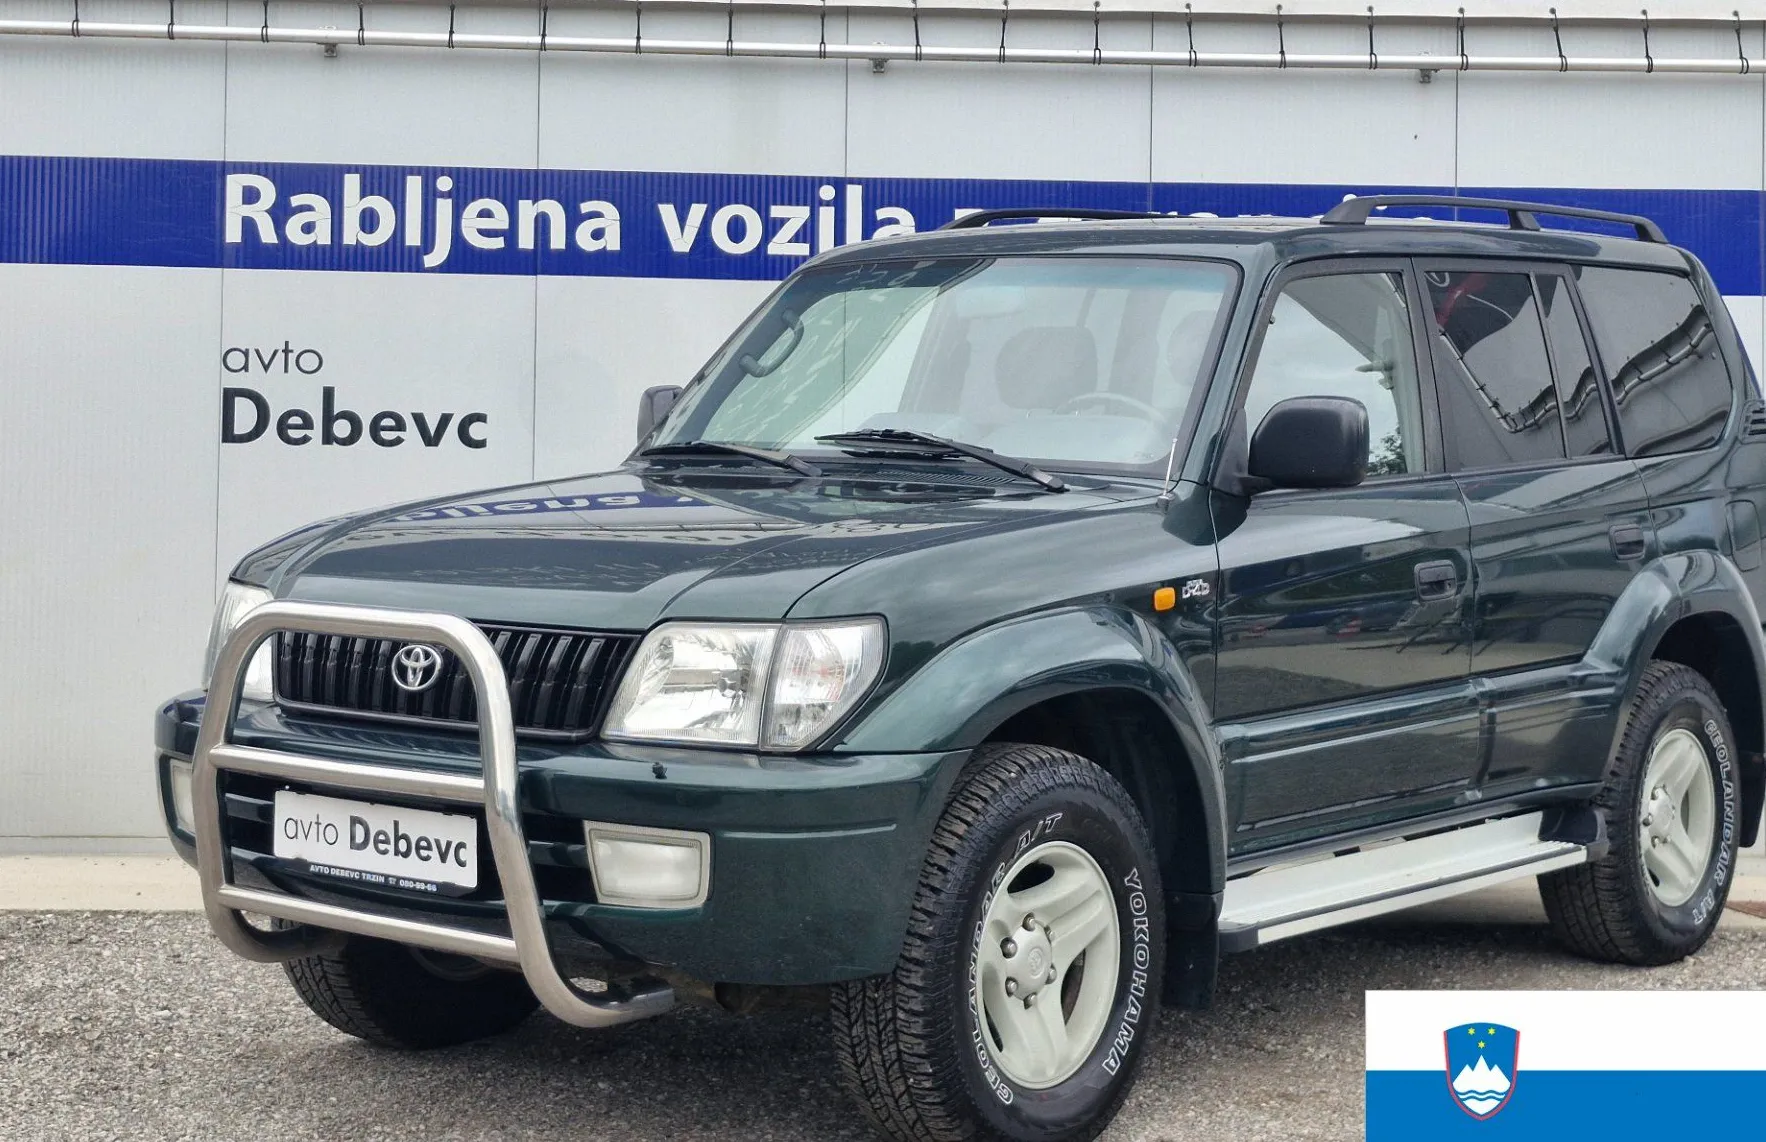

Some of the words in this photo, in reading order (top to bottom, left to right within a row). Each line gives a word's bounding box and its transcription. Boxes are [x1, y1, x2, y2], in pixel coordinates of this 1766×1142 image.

[224, 172, 621, 268] Rabljena
[658, 184, 917, 256] vozila
[221, 340, 323, 375] avto
[221, 386, 488, 448] Debevc
[1704, 719, 1736, 887] GEOLANDAR
[284, 814, 339, 845] avto
[349, 815, 467, 868] Debevc
[1013, 812, 1063, 858] A/T
[309, 864, 330, 875] AVTO
[330, 868, 360, 880] DEBEVC
[361, 872, 385, 884] TRZIN
[1102, 867, 1150, 1077] YOKOHAMA
